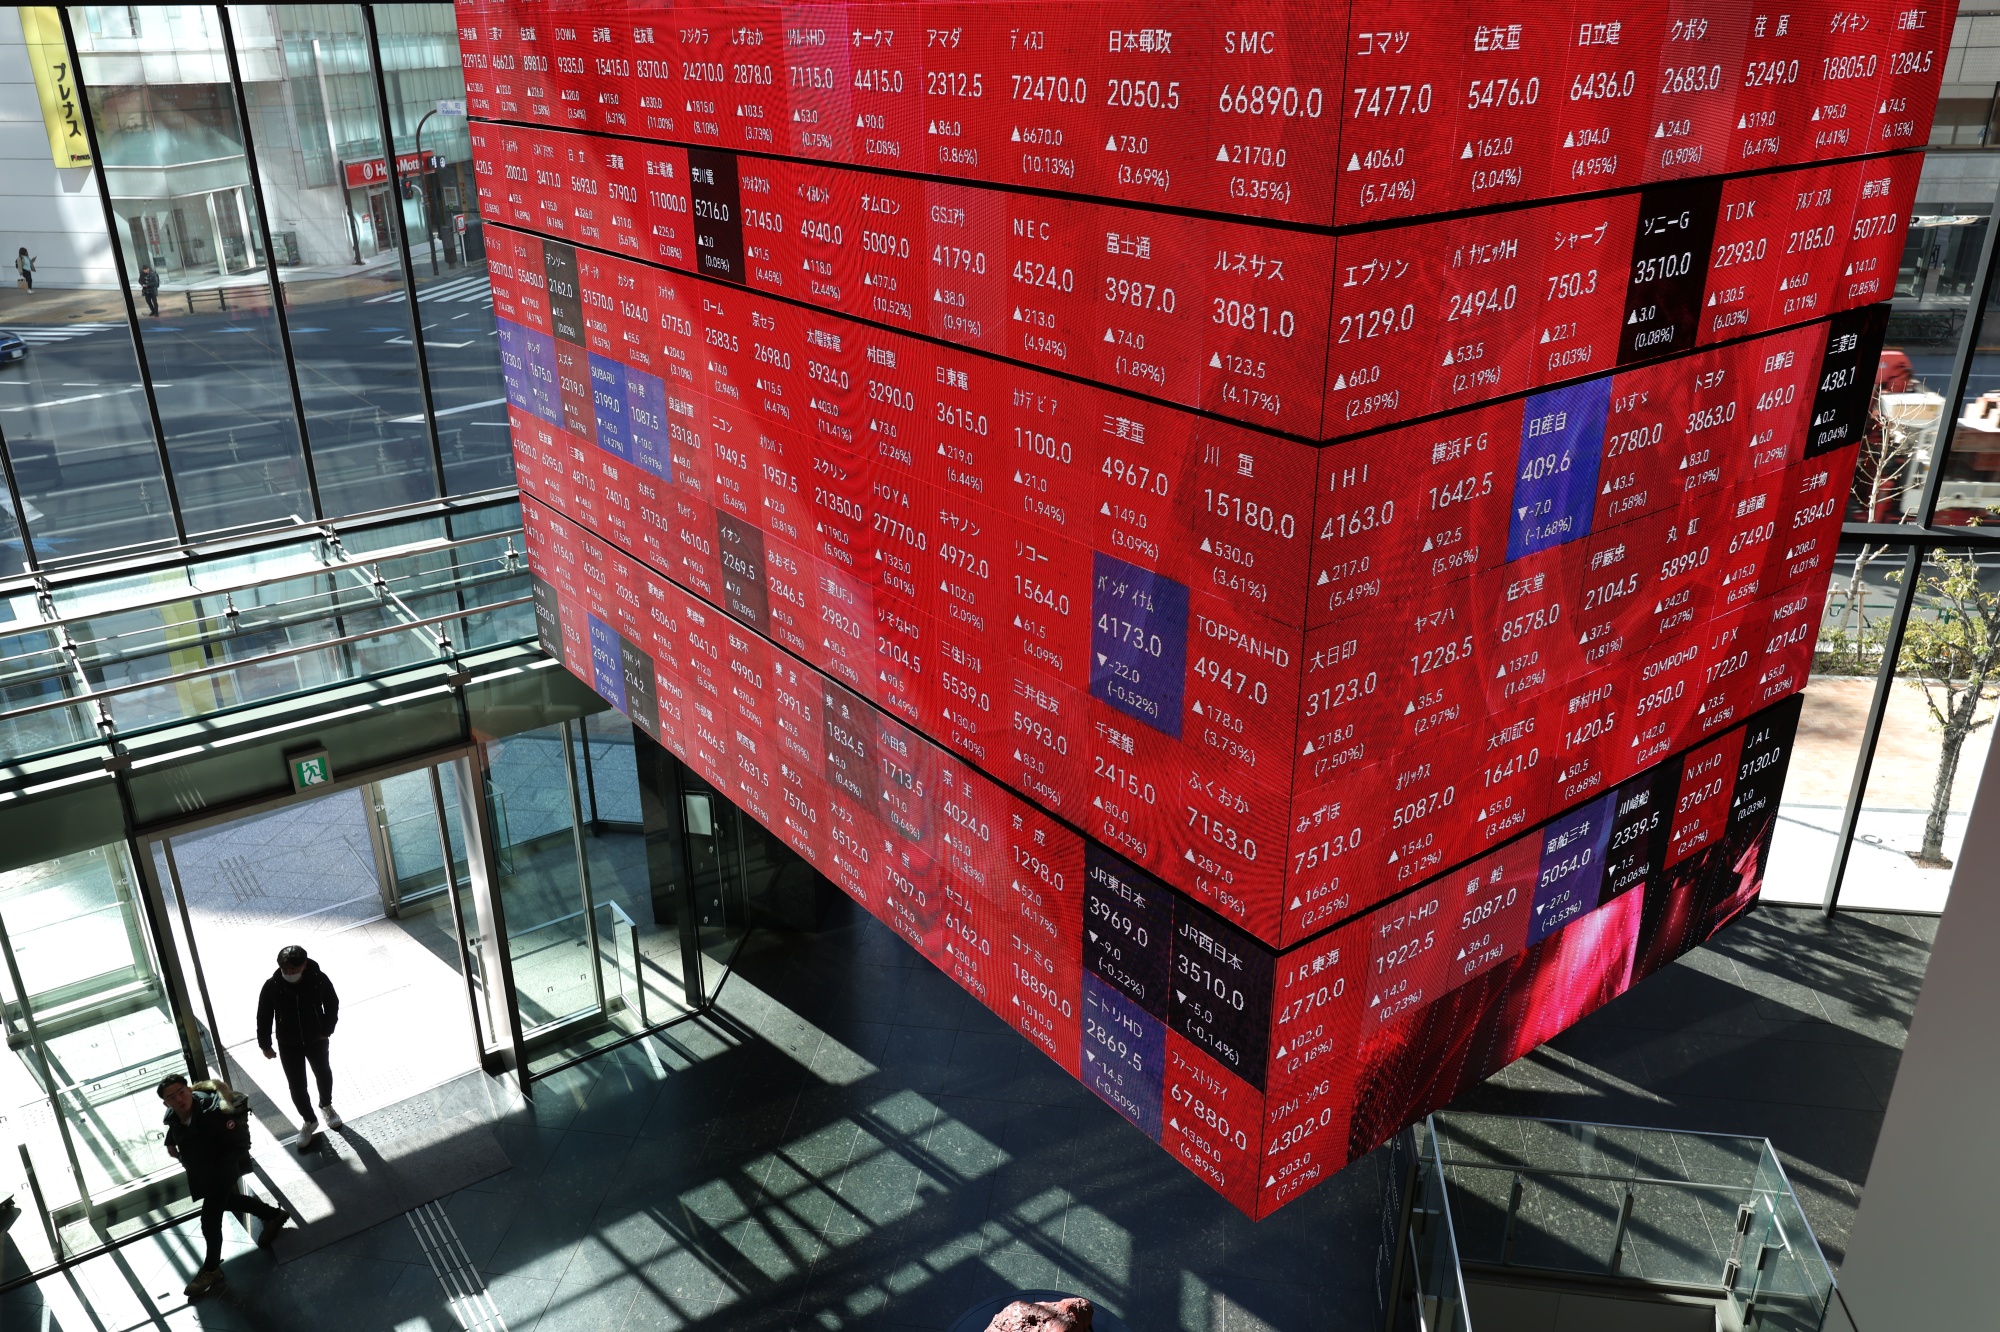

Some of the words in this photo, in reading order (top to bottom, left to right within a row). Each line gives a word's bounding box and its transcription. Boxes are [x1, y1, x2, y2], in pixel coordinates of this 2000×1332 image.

[679, 28, 709, 45] フジクラ
[926, 26, 963, 49] アマダ
[1578, 19, 1622, 47] 日立建
[1830, 11, 1870, 34] ダイキン
[1109, 29, 1172, 54] 日本郵政
[1357, 30, 1410, 55] コマツ
[557, 56, 585, 74] 9335.0
[682, 61, 724, 83] 24210.0
[1661, 64, 1722, 94] 2683.0
[1822, 54, 1877, 81] 18805.0
[927, 71, 983, 97] 2312.5
[1107, 79, 1180, 110] 2050.5
[1570, 70, 1635, 101] 6436.0
[53, 62, 82, 138] プレナス
[1219, 84, 1323, 118] 66890.0
[1353, 83, 1432, 119] 7477.0
[1821, 103, 1847, 120] 795.0
[1120, 135, 1148, 155] 73.0
[1576, 127, 1610, 147] 304.0
[1815, 127, 1850, 149] (4.41%)
[939, 145, 978, 168] (3.86%)
[1231, 144, 1286, 168] 2170.0
[1363, 147, 1405, 170] 406.0
[1571, 154, 1617, 180] (4.95%)
[691, 166, 715, 186] 安川電
[1117, 164, 1170, 192] (3.69%)
[1230, 176, 1291, 205] (3.35%)
[861, 193, 901, 215] オムロン
[1360, 178, 1416, 208] (5.74%)
[695, 198, 729, 222] 5216.0
[1644, 210, 1690, 236] ソニーG
[1554, 221, 1609, 251] シャープ
[1852, 213, 1897, 241] 5077.0
[862, 230, 909, 259] 5009.0
[1106, 232, 1151, 260] 富士通
[1213, 250, 1285, 281] ルネサス
[1343, 258, 1410, 288] エプソン
[1634, 251, 1692, 284] 3510.0
[548, 278, 573, 298] 2162.0
[1105, 276, 1176, 314] 3987.0
[1547, 269, 1598, 302] 750.3
[1212, 297, 1295, 338] 3081.0
[1337, 303, 1415, 344] 2129.0
[1551, 322, 1577, 342] 22.1
[1118, 329, 1145, 350] 74.0
[1634, 324, 1675, 351] (0.08%)
[1116, 355, 1166, 387] (1.89%)
[1226, 354, 1266, 379] 123.5
[1548, 344, 1592, 372] (3.03%)
[808, 360, 849, 390] 3934.0
[936, 366, 969, 391] 日東電
[1349, 365, 1381, 388] 60.0
[1694, 368, 1726, 393] トヨタ
[1820, 365, 1856, 393] 438.1
[594, 390, 620, 413] 3199.0
[1222, 382, 1281, 416] (4.17%)
[1345, 389, 1400, 421] (2.89%)
[712, 415, 733, 433] ニコン
[936, 401, 988, 436] 3615.0
[1102, 414, 1146, 445] 三菱重
[1528, 410, 1567, 439] 日産自
[1685, 401, 1736, 435] 3863.0
[714, 442, 747, 470] 1949.5
[947, 445, 973, 466] 219.0
[1521, 449, 1571, 482] 409.6
[947, 466, 983, 494] (6.44%)
[1101, 456, 1168, 497] 4967.0
[1684, 466, 1720, 493] (2.19%)
[939, 508, 981, 536] キヤノン
[1528, 498, 1552, 517] -7.0
[720, 526, 741, 544] イオン
[1111, 528, 1159, 563] (3.09%)
[1525, 515, 1573, 546] (-1.68%)
[722, 550, 755, 580] 2269.5
[768, 549, 798, 575] あおぞら
[939, 542, 989, 579] 4972.0
[1015, 539, 1049, 562] リコー
[769, 576, 805, 608] 2846.5
[950, 583, 975, 605] 102.0
[1014, 574, 1069, 616] 1564.0
[1506, 572, 1545, 602] 任天堂
[1584, 572, 1639, 611] 2104.5
[949, 603, 984, 632] (2.09%)
[1501, 603, 1560, 643] 8578.0
[1772, 596, 1808, 623] MS&AD
[1196, 614, 1289, 668] TOPPANHD
[1765, 622, 1808, 655] 4214.0
[1309, 639, 1357, 673] 大日印
[1509, 651, 1539, 673] 137.0
[1642, 645, 1698, 681] SOMPOHD
[1193, 656, 1268, 705] 4947.0
[1305, 671, 1377, 717] 3123.0
[1504, 668, 1546, 699] (1.62%)
[1636, 679, 1685, 717] 5950.0
[1207, 705, 1243, 734] 178.0
[1486, 717, 1535, 752] 大和証G
[827, 721, 864, 758] 1834.5
[1204, 728, 1256, 767] (3.73%)
[1317, 723, 1354, 751] 218.0
[1314, 742, 1364, 778] (7.50%)
[1484, 747, 1539, 788] 1641.0
[783, 787, 817, 824] 7570.0
[1188, 770, 1249, 814] ふくおか
[1296, 801, 1341, 833] みずほ
[1187, 805, 1257, 861] 7153.0
[1545, 820, 1591, 856] 商船三井
[1294, 827, 1362, 875] 7513.0
[1540, 847, 1592, 888] 5054.0
[1089, 866, 1146, 909] JR東日本
[1196, 875, 1245, 917] (4.18%)
[1305, 877, 1339, 903] 166.0
[1545, 889, 1571, 910] -27.0
[1089, 896, 1148, 947] 3969.0
[1301, 893, 1350, 929] (2.25%)
[1379, 899, 1439, 938] ヤマトHD
[1541, 899, 1582, 933] (-0.53%)
[1012, 934, 1054, 974] コナミG
[1178, 923, 1243, 971] JR西日本
[1376, 929, 1435, 974] 1922.5
[1012, 962, 1071, 1018] 18890.0
[1098, 956, 1145, 1000] (-0.22%)
[1178, 953, 1245, 1011] 3510.0
[1383, 979, 1407, 1000] 14.0
[1087, 990, 1143, 1038] ニトリHD
[1278, 977, 1345, 1025] 4770.0
[1379, 988, 1423, 1023] (0.73%)
[1086, 1018, 1142, 1072] 2869.5
[1186, 1018, 1240, 1066] (-0.14%)
[1291, 1024, 1323, 1051] 102.0
[1287, 1037, 1333, 1075] (2.18%)
[1095, 1075, 1140, 1120] (-0.50%)
[1171, 1083, 1247, 1151] 67880.0
[1267, 1107, 1331, 1156] 4302.0
[1180, 1142, 1225, 1187] (6.89%)
[1278, 1152, 1311, 1180] 303.0
[1276, 1163, 1321, 1201] (7.57%)
